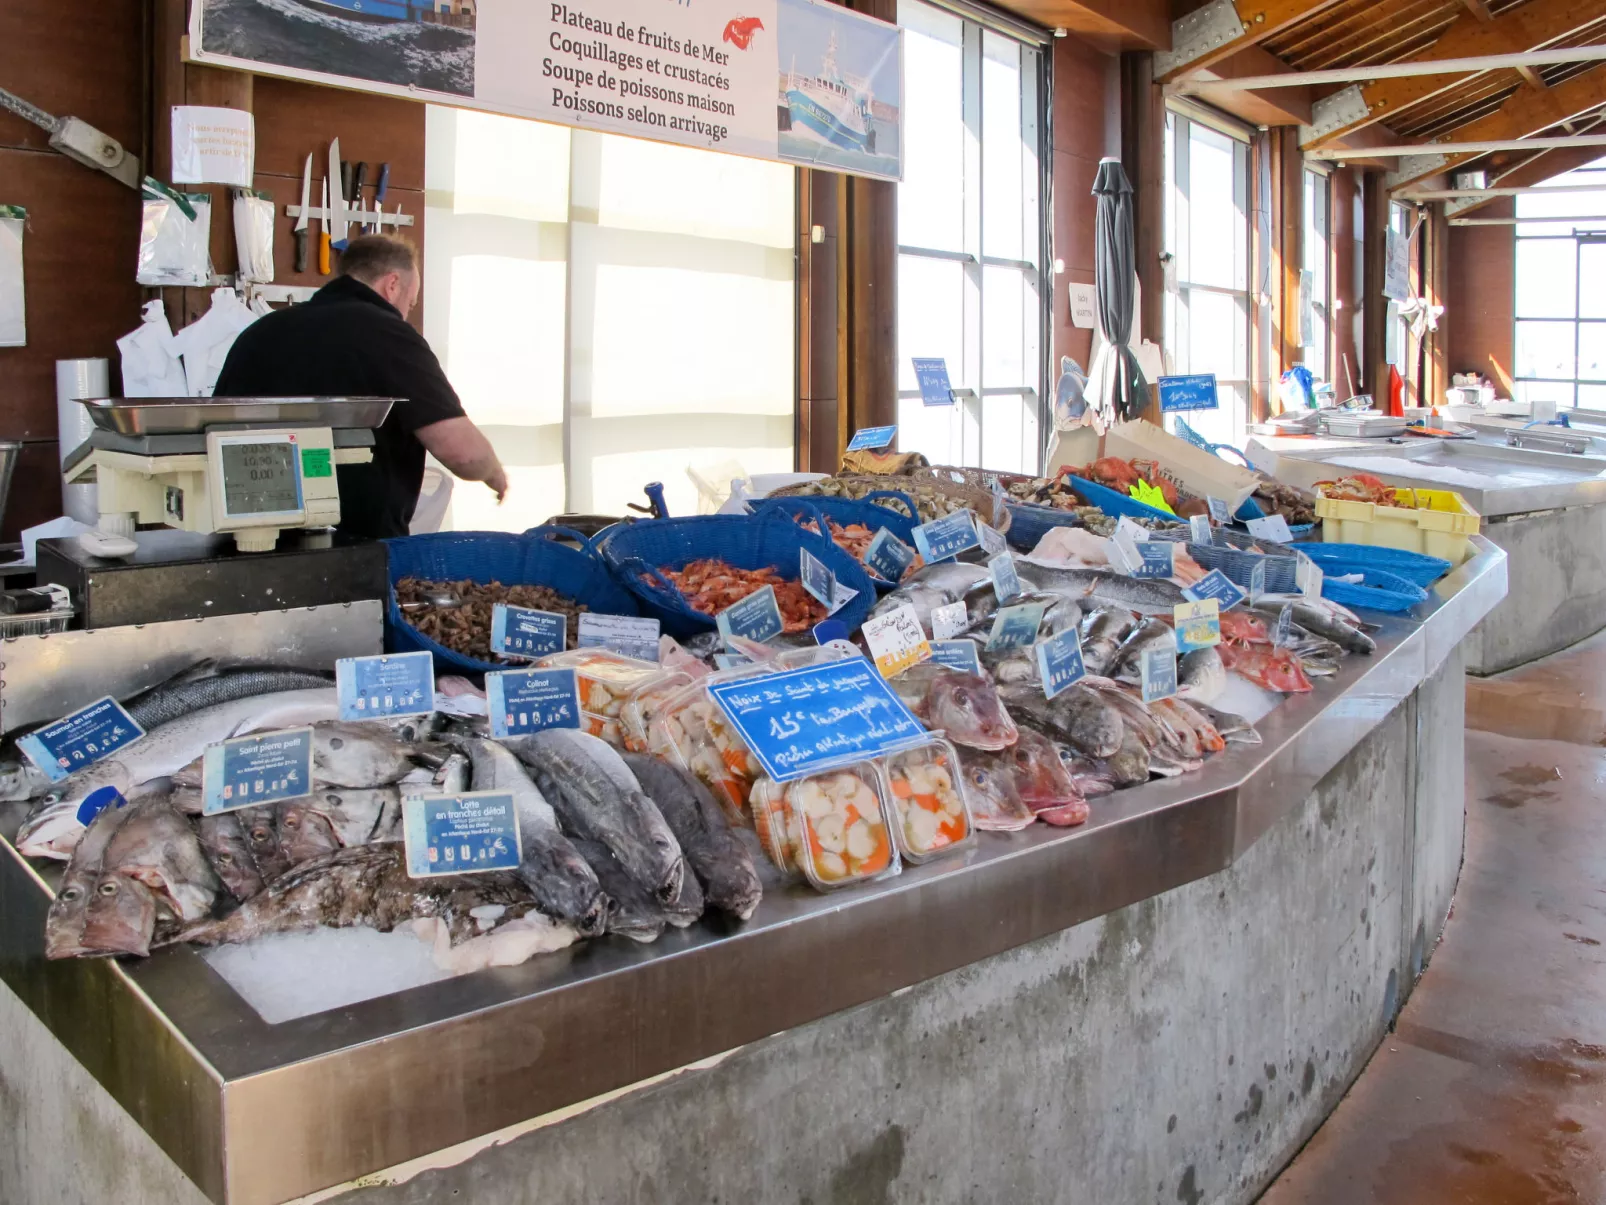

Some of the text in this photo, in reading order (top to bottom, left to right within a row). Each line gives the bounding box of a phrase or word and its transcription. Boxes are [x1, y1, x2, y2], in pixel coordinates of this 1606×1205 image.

[551, 3, 729, 66] Plateau de fruits de Mer
[549, 32, 730, 90] Coquillages et crustacés
[542, 58, 735, 117] Soupe de poissons maison
[552, 88, 728, 142] Poissons selon arrivage
[516, 613, 540, 621] Crevettes
[541, 617, 556, 625] grises
[526, 678, 549, 688] Colinot
[728, 694, 762, 709] Noix
[45, 703, 112, 739] Saumon en tranches
[239, 737, 301, 755] Saint pierre petit
[435, 805, 505, 820] en tranches détail
[459, 800, 479, 809] Lotte
